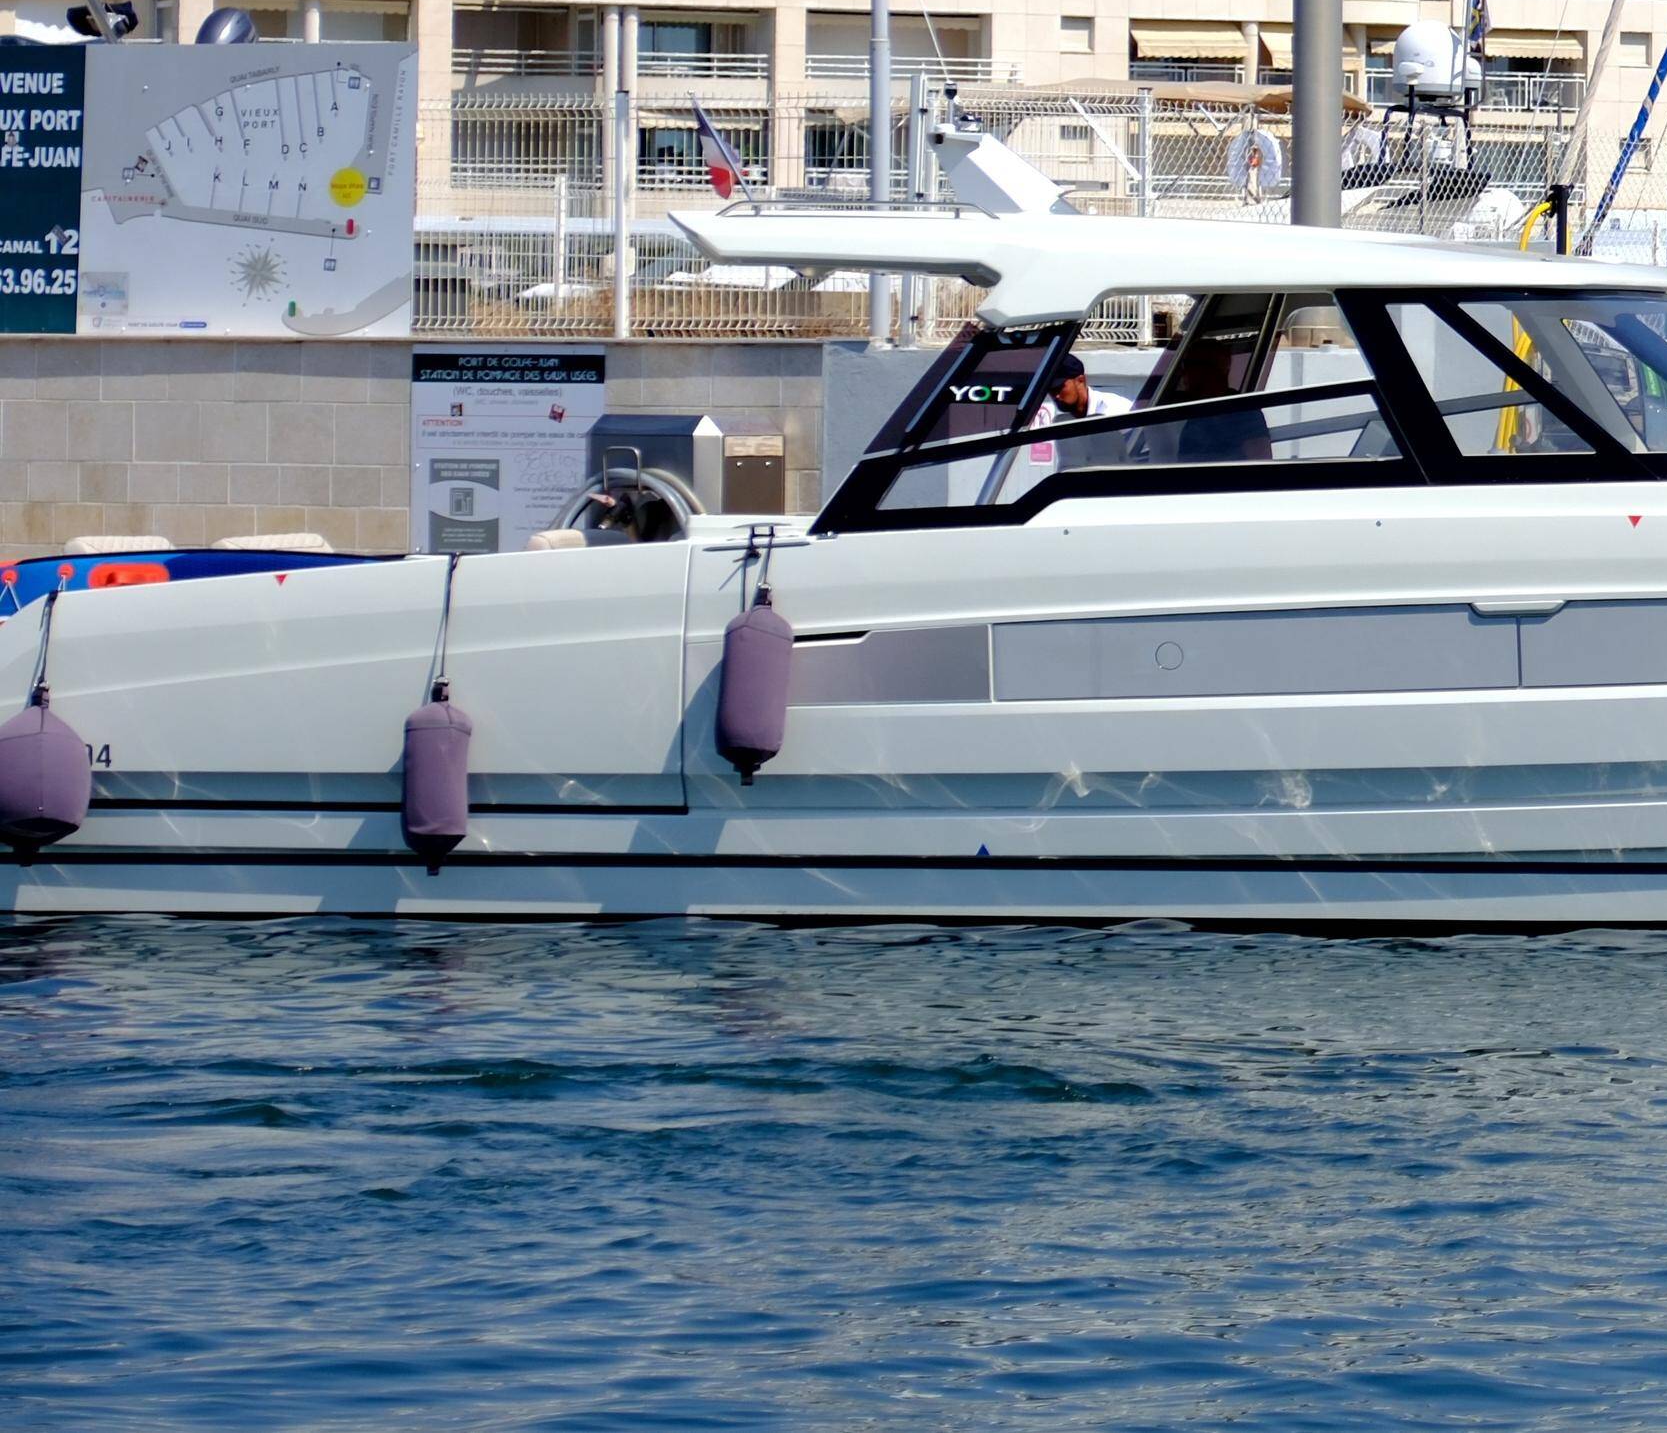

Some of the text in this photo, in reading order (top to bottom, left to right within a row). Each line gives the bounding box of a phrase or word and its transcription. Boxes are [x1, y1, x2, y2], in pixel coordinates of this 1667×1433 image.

[0, 72, 64, 95] VENUE
[330, 101, 339, 112] A
[215, 107, 224, 117] G
[241, 109, 279, 117] VIEUX
[0, 109, 81, 131] UX PORT
[243, 120, 276, 129] PORT
[316, 127, 325, 137] B
[165, 140, 172, 151] J
[215, 136, 224, 146] H
[243, 139, 251, 149] F
[281, 145, 289, 154] D
[299, 143, 307, 153] C
[0, 146, 81, 168] FE-JUAN
[213, 172, 221, 183] K
[242, 176, 249, 187] L
[268, 180, 279, 190] M
[298, 182, 307, 191] N
[44, 229, 79, 255] 12
[0, 268, 77, 295] 3.96.25
[458, 357, 483, 367] PORT
[487, 357, 499, 366] DE
[420, 369, 460, 380] STATION
[462, 370, 474, 380] DE
[477, 370, 521, 380] POMPAGE
[524, 370, 541, 380] DES
[949, 386, 1013, 402] YOT
